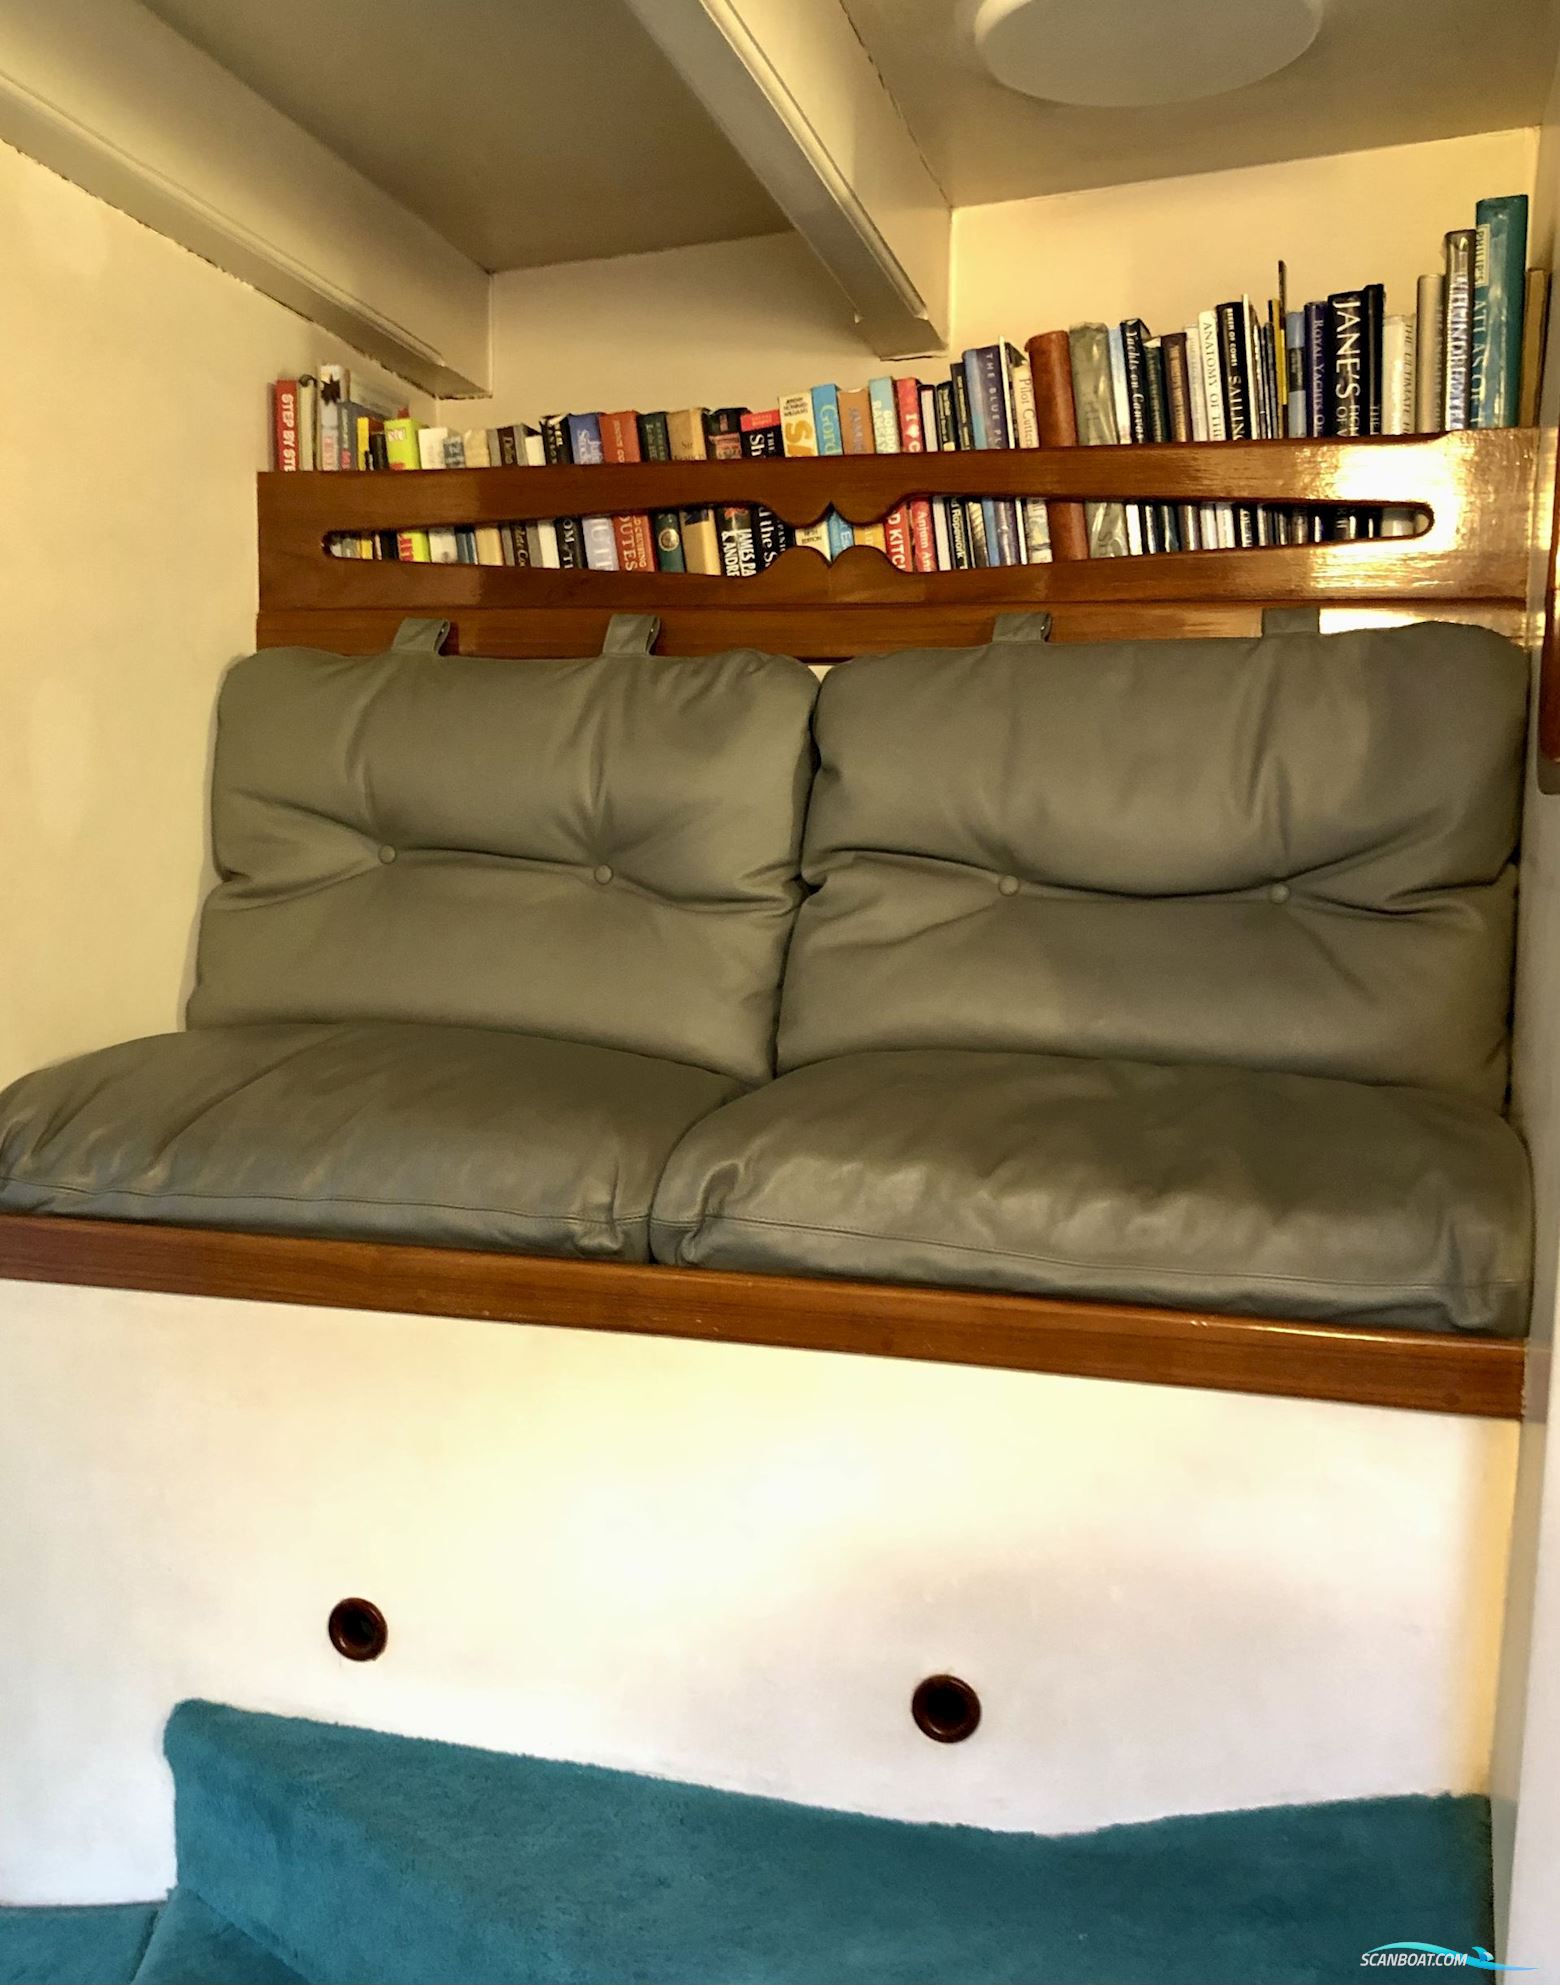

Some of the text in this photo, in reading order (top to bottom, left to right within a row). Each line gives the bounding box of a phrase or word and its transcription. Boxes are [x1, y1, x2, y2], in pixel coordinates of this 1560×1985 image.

[1226, 307, 1236, 330] BEKEN
[1228, 331, 1237, 342] OF
[1313, 319, 1325, 358] ROYAL
[1472, 299, 1487, 368] ATLAS
[1125, 331, 1141, 370] Yachts
[1202, 322, 1218, 388] ANATOMY
[1229, 343, 1238, 367] COWES
[1332, 299, 1361, 399] JANE'S
[985, 352, 1003, 450] THE BLUE PL
[1018, 377, 1032, 405] Pilot
[1130, 373, 1139, 389] on
[1209, 393, 1221, 408] OF
[1313, 362, 1325, 411] YACHTS
[281, 393, 297, 472] STEP BY STE
[820, 404, 842, 454] Gord
[872, 400, 888, 454] RAMSAY
[884, 410, 897, 452] GORDO
[1348, 404, 1361, 437] FIGH
[759, 520, 775, 548] the
[917, 511, 930, 549] Anjum
[952, 509, 966, 559] Ropework
[737, 528, 757, 577] JAMES PA
